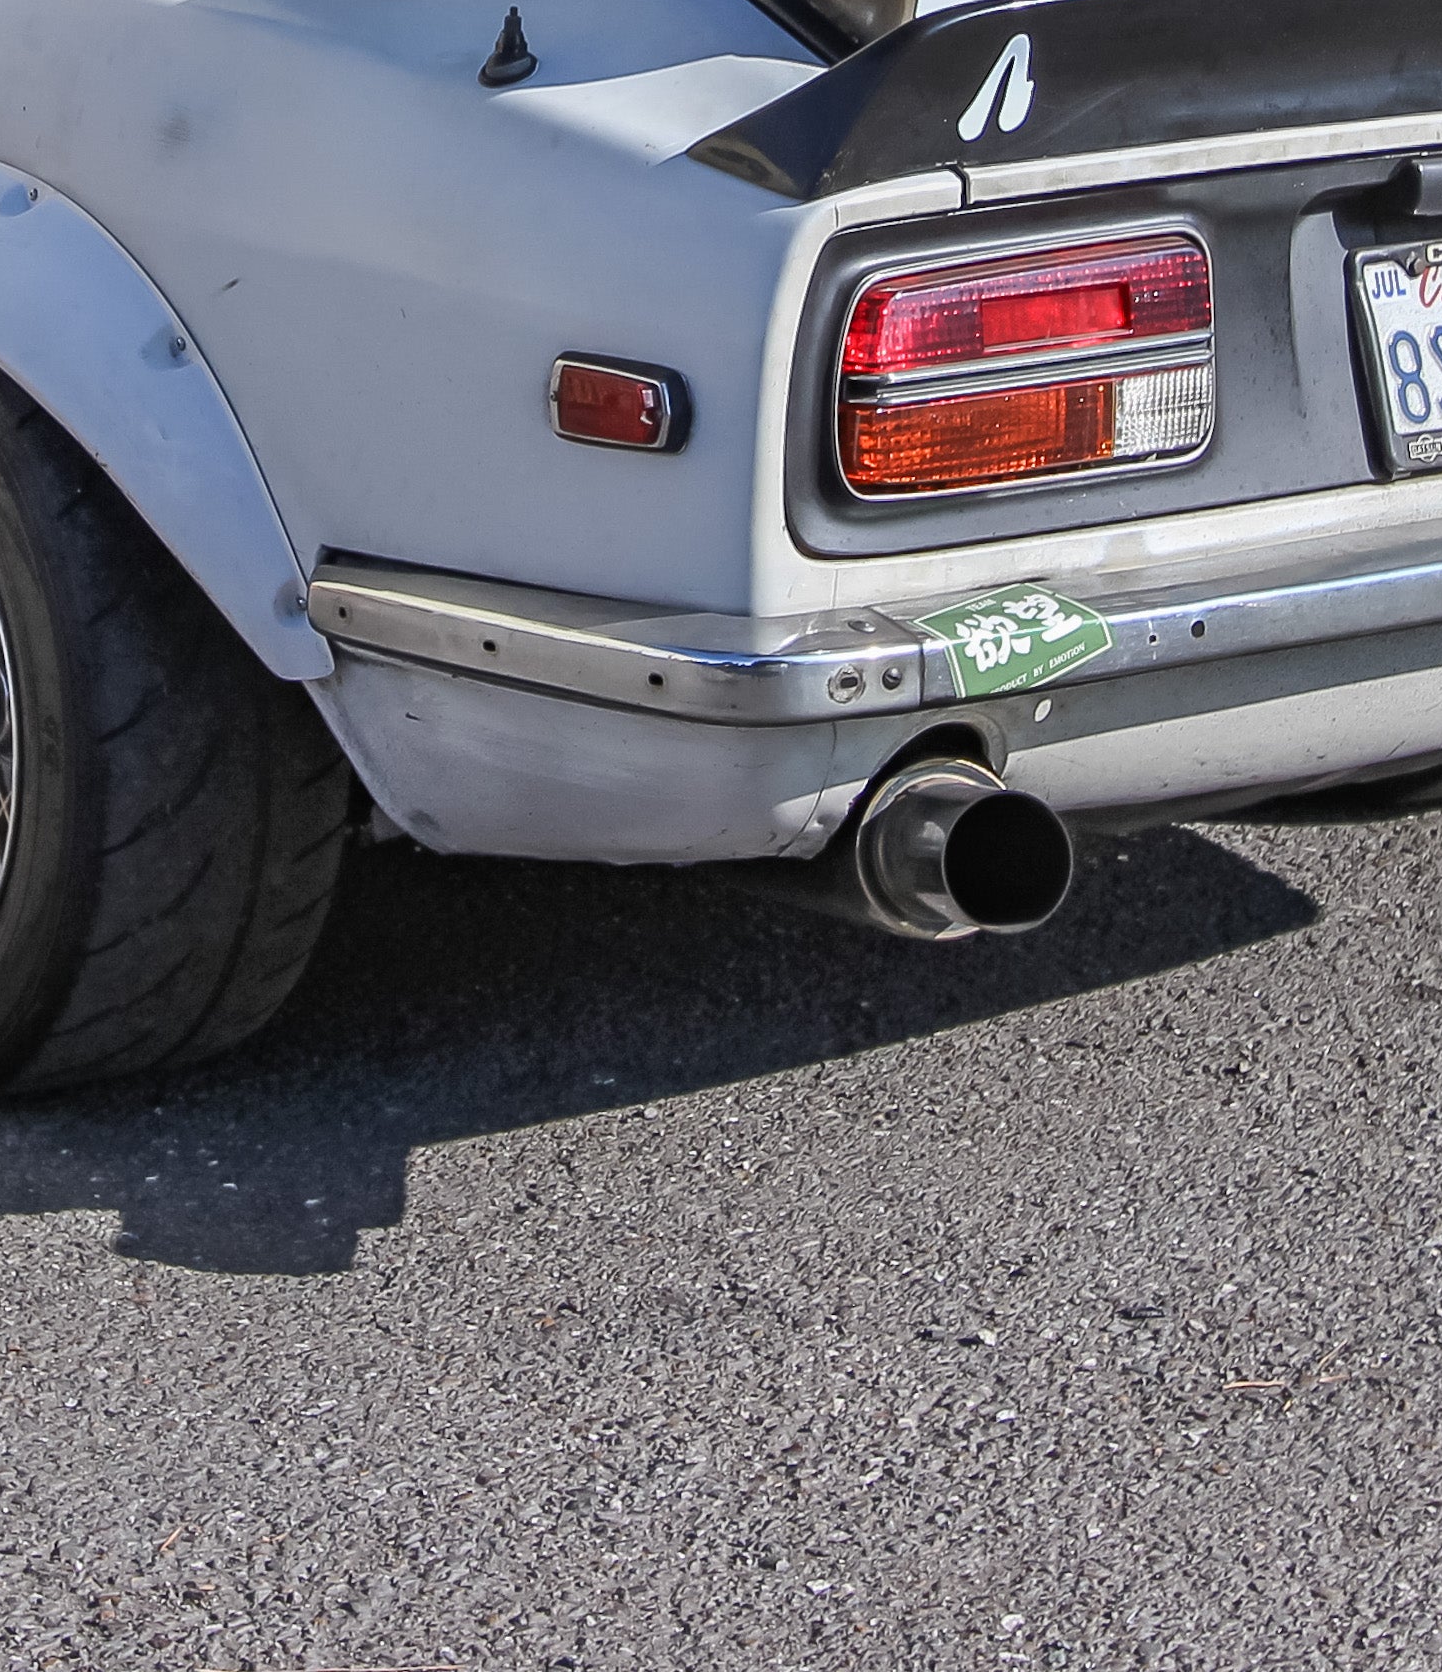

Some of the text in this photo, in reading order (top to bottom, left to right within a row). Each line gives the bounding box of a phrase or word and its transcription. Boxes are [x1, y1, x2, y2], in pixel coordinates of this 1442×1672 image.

[1371, 269, 1407, 300] JUL
[1033, 664, 1045, 678] BY
[1049, 641, 1086, 670] EMOTION
